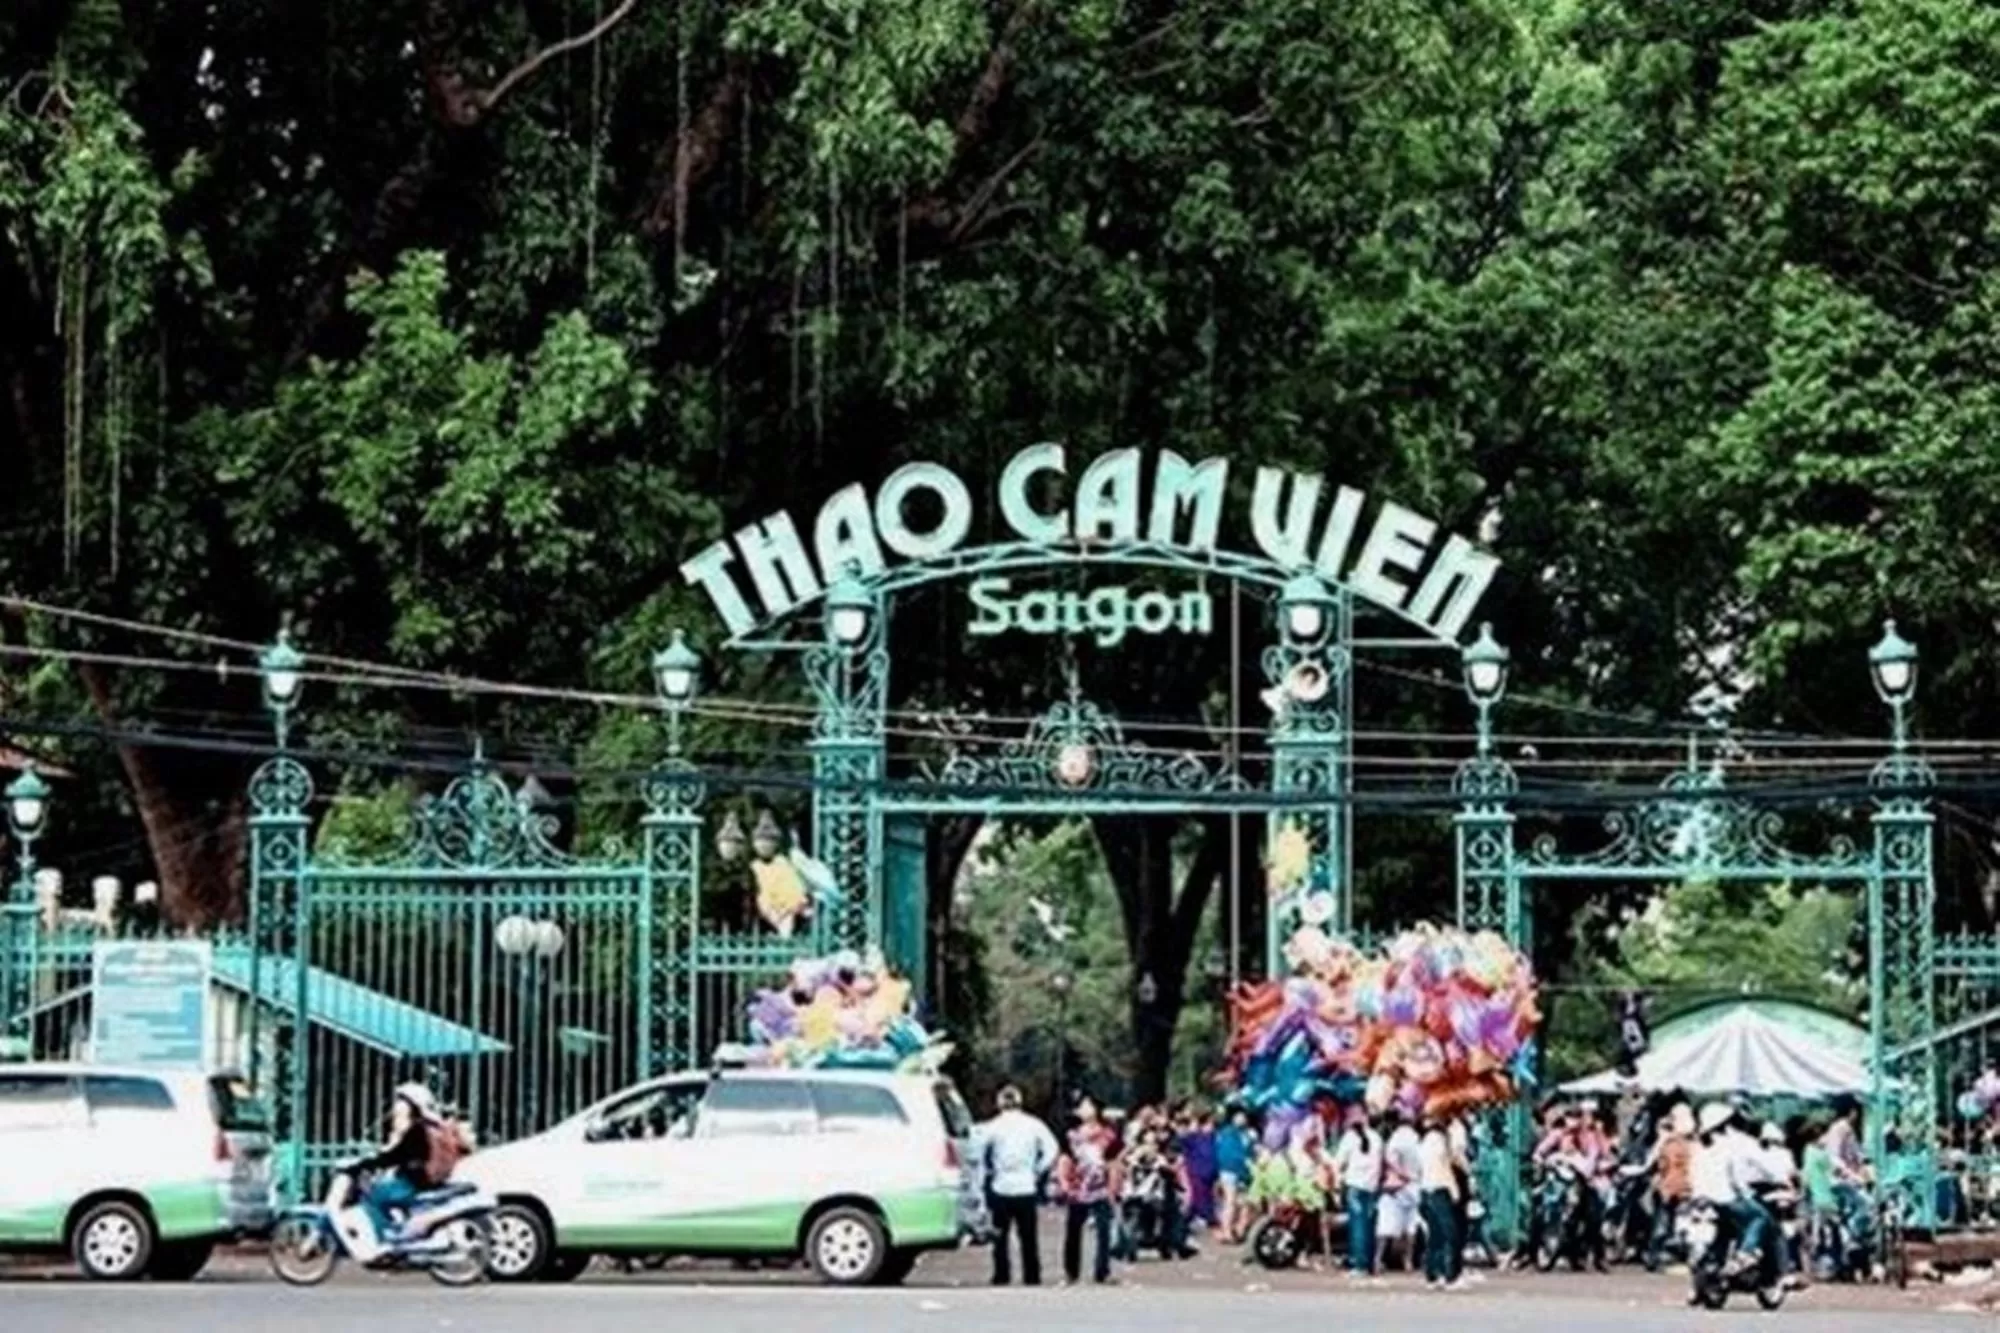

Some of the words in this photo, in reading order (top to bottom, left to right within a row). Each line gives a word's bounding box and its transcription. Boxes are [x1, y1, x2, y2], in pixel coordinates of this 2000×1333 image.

[679, 460, 972, 636] THAO
[998, 441, 1228, 552] CAM
[968, 578, 1212, 647] Saigon
